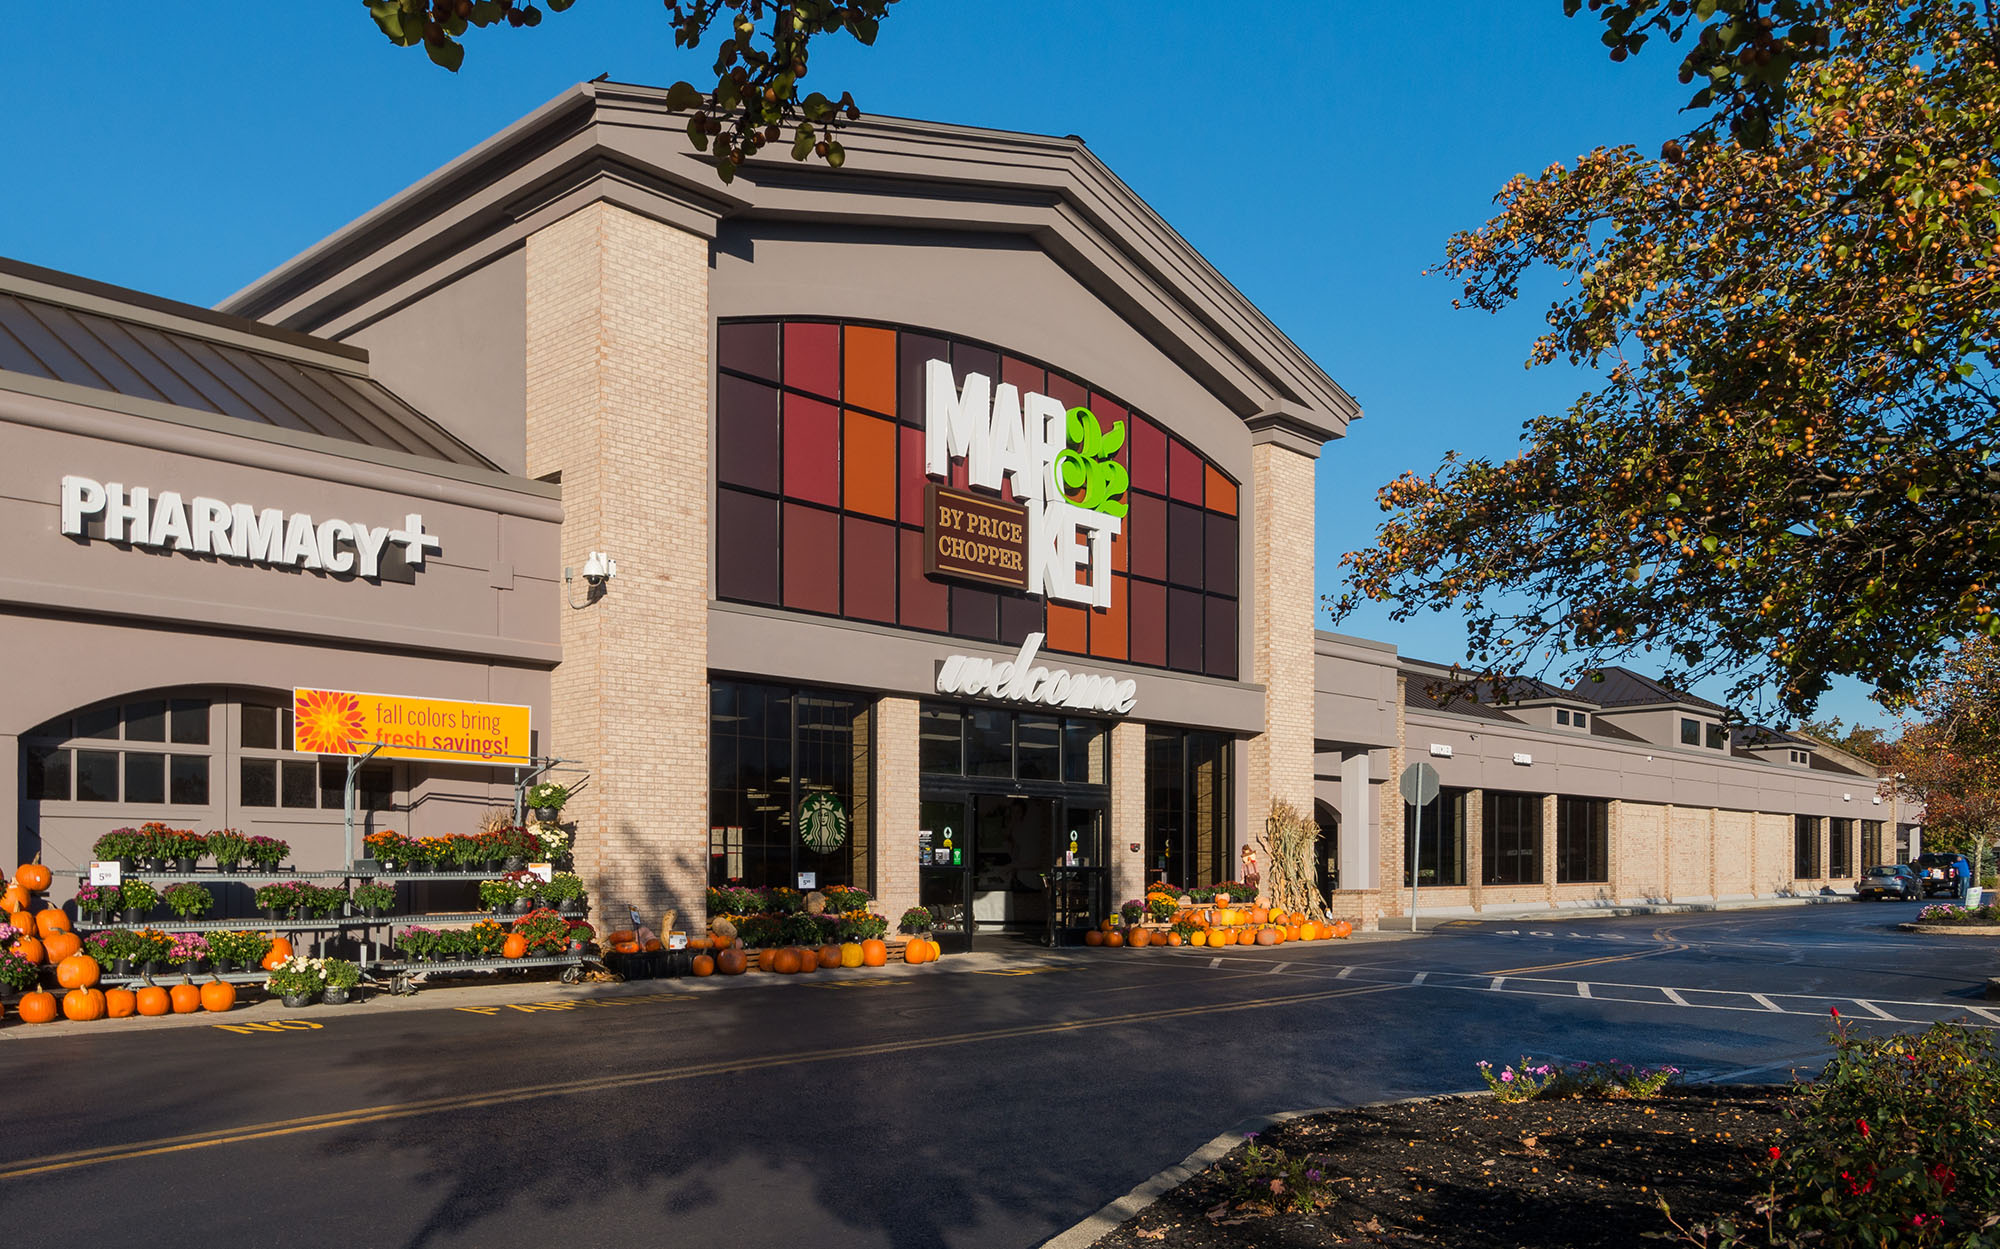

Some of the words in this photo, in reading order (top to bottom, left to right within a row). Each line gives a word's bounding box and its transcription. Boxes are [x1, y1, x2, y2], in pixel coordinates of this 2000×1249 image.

[939, 506, 964, 530] BY
[966, 513, 1023, 544] PRICE
[938, 535, 1024, 572] CHOPPER
[936, 632, 1138, 714] welcome
[376, 703, 402, 725] fall
[407, 706, 457, 728] colors
[461, 709, 501, 735] bring
[376, 727, 426, 749] fresh
[432, 733, 509, 759] savings!
[211, 1020, 325, 1035] NO
